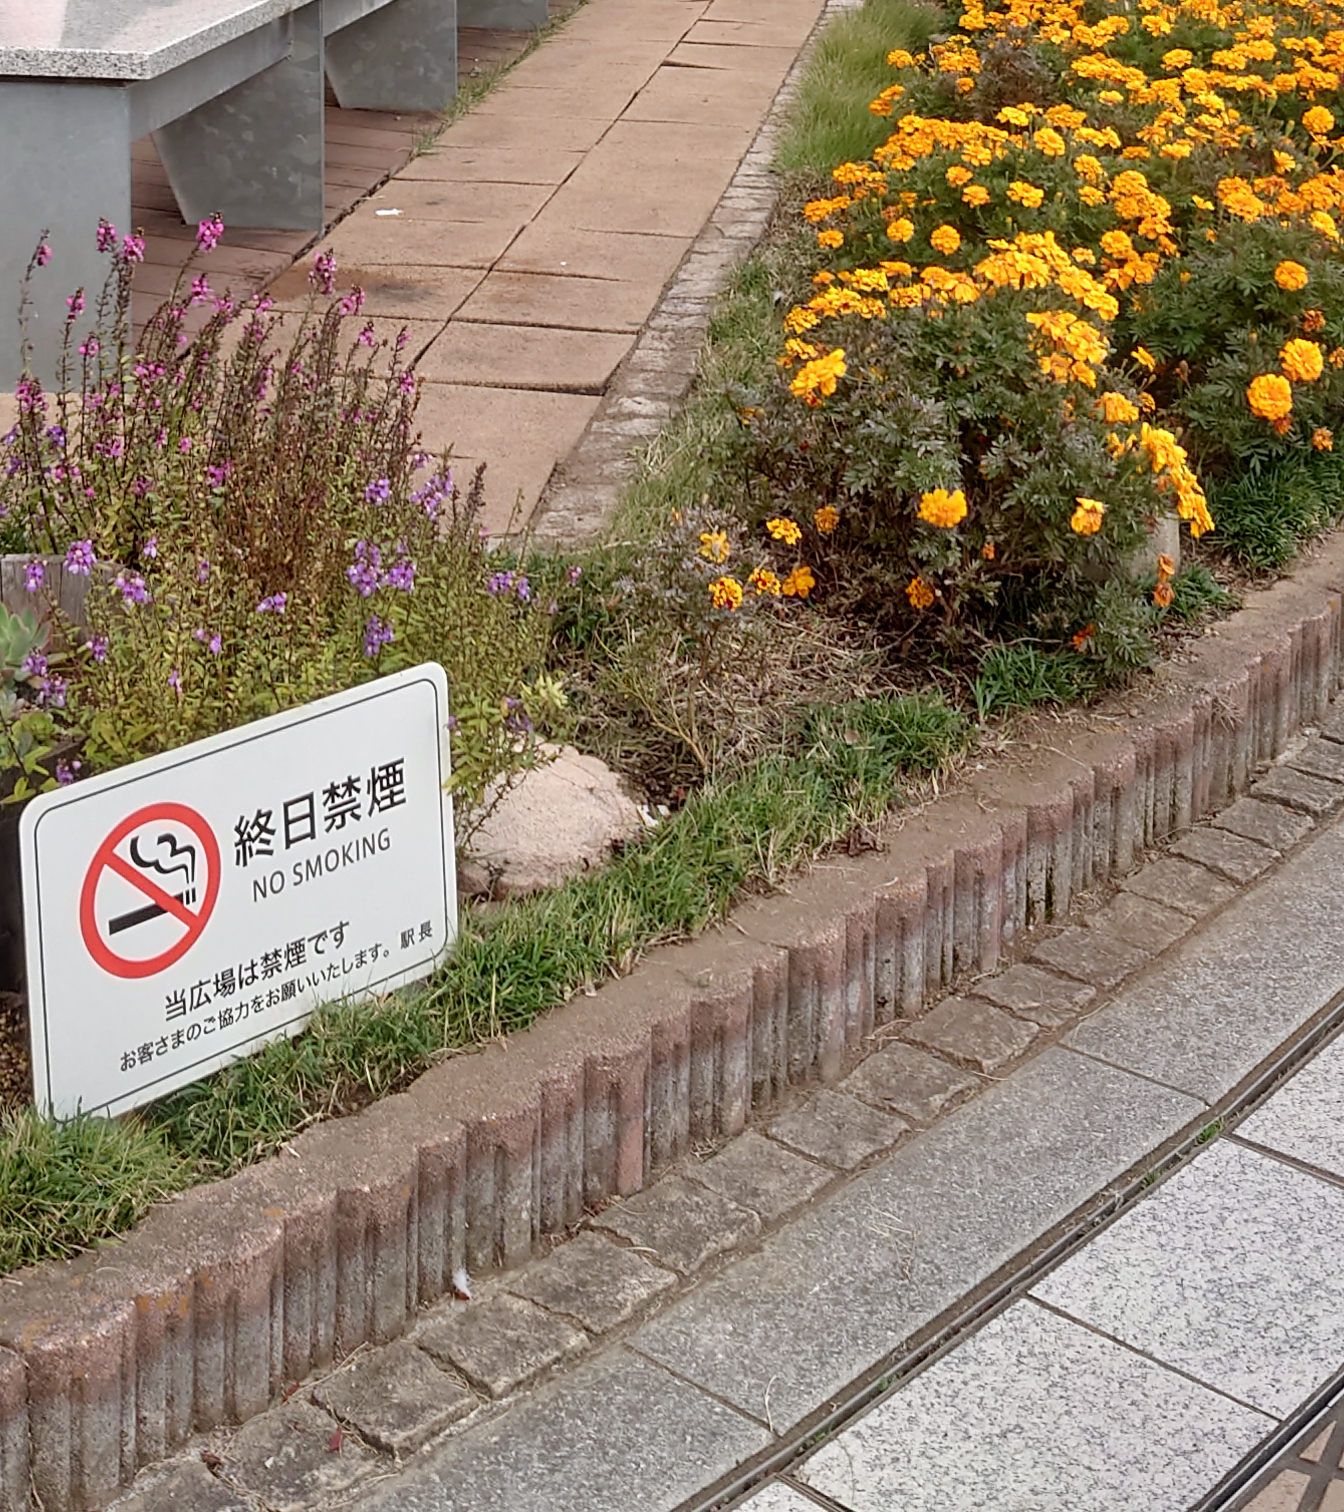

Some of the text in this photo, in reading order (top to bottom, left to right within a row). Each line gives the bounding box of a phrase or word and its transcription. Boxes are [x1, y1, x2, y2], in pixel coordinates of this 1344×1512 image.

[234, 758, 407, 868] 終日禁煙
[252, 828, 391, 902] NO SMOKING
[120, 920, 433, 1072] お客さまのご協力をお願いいたします。 駅長
[165, 921, 350, 1021] 当広場は禁煙です
